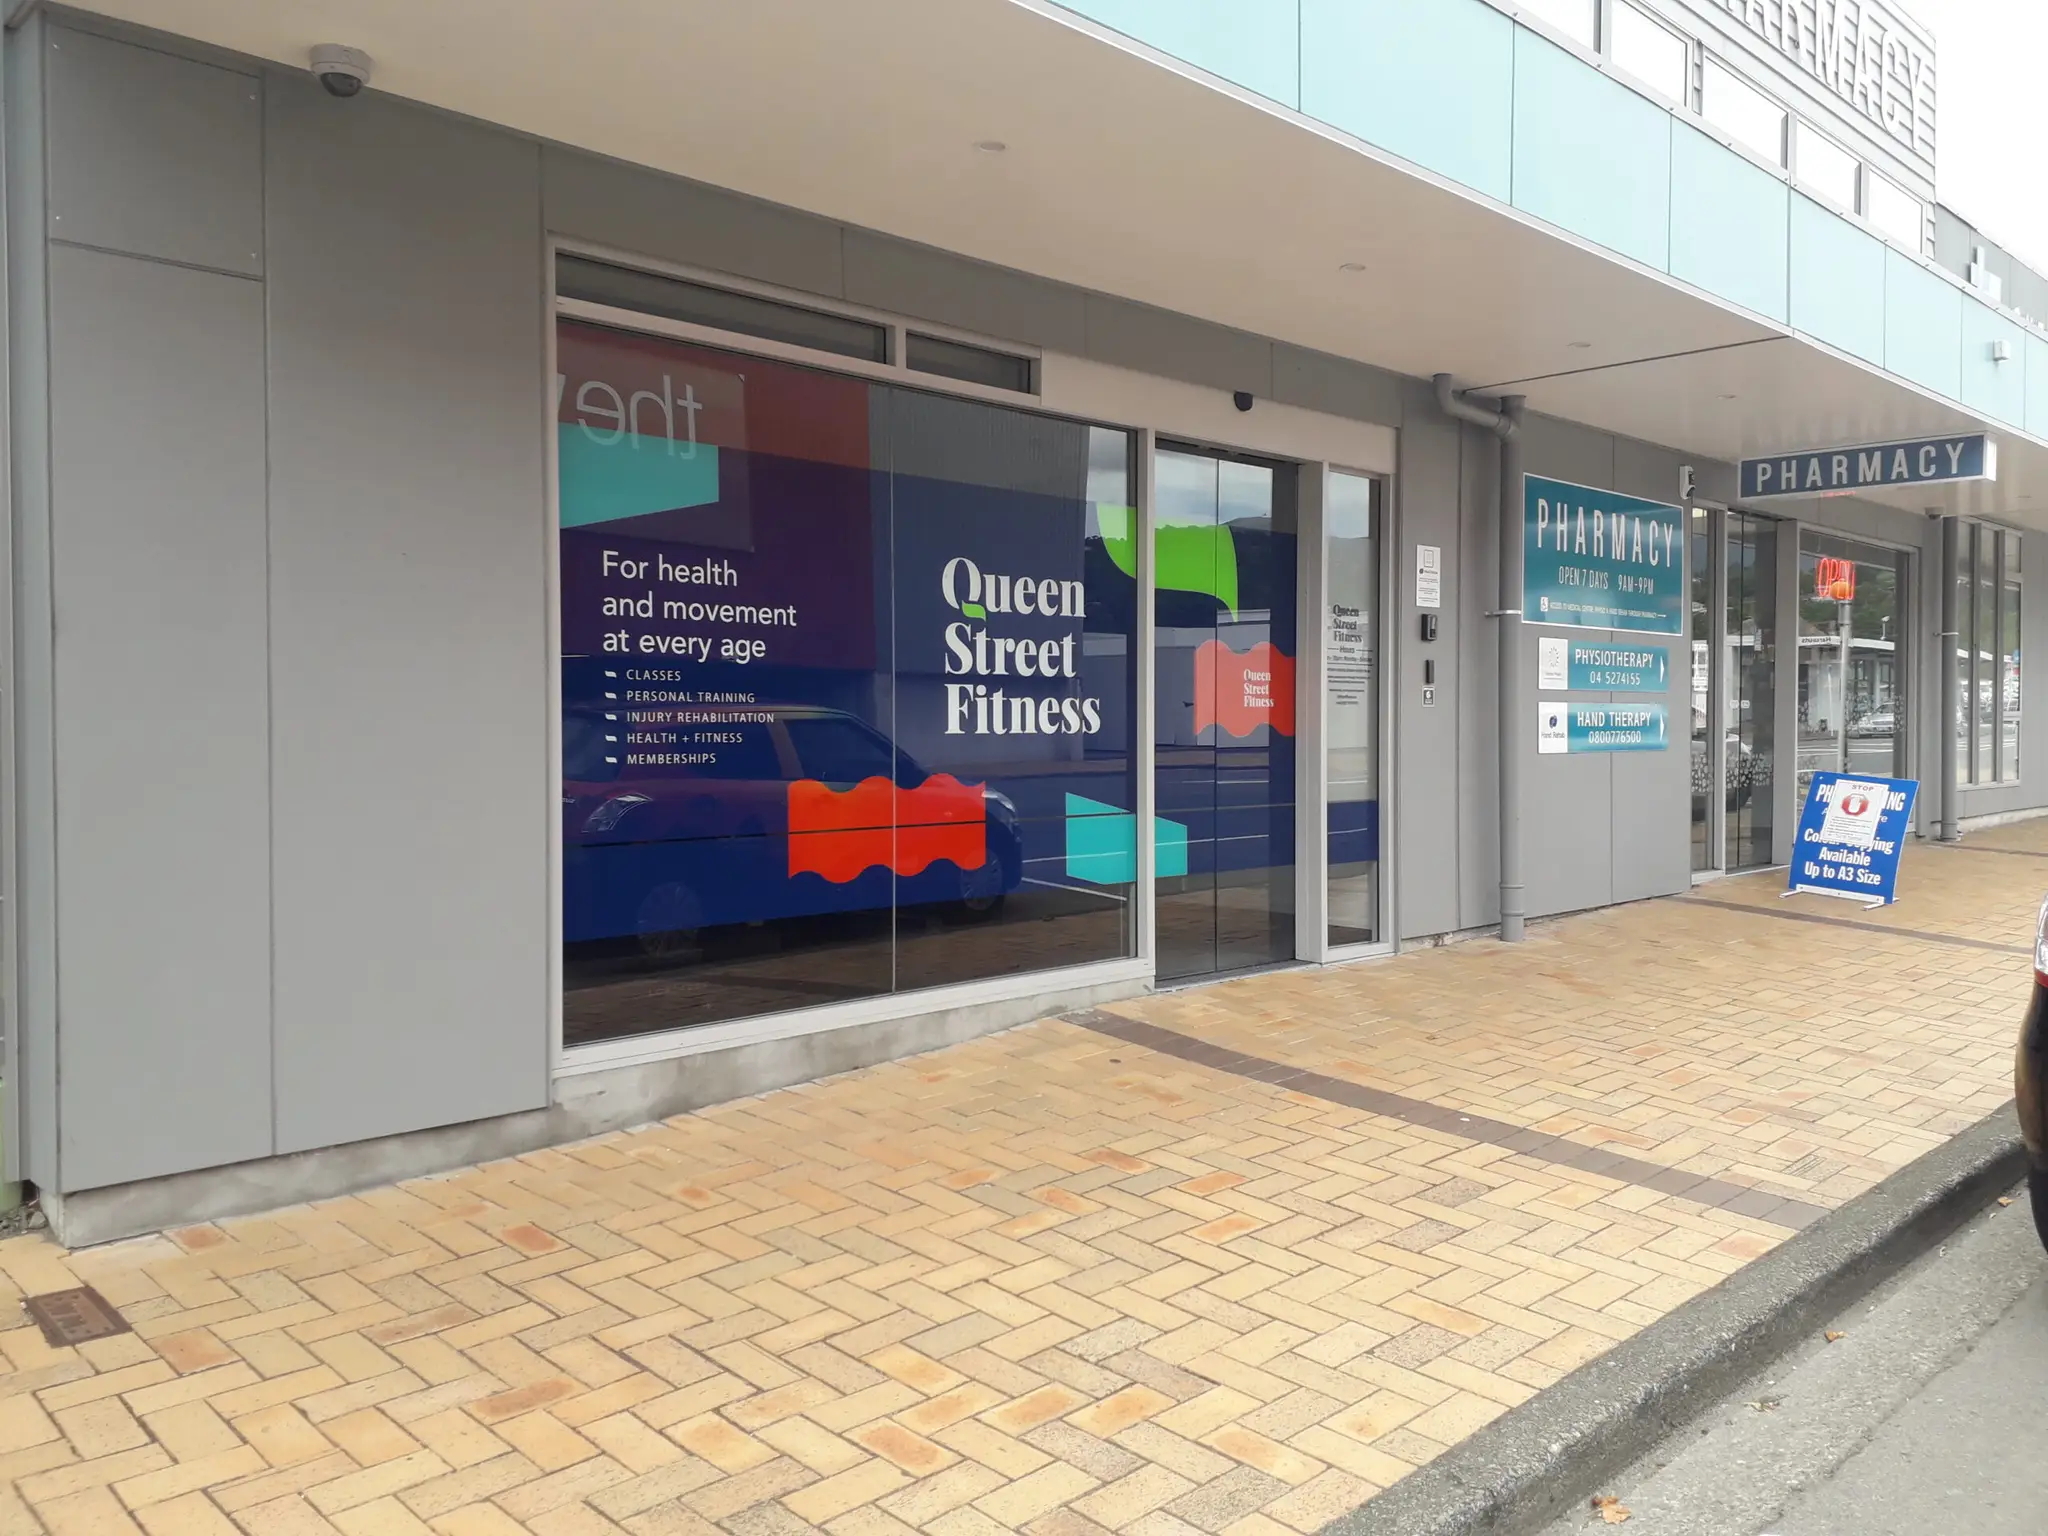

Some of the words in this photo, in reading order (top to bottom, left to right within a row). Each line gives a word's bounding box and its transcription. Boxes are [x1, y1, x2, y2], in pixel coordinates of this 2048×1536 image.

[1757, 442, 1964, 492] PHARMACY
[1537, 498, 1673, 567] PHARMACY
[603, 550, 649, 579] For
[658, 553, 738, 587] health
[1558, 566, 1579, 586] OPEN
[1582, 569, 1587, 587] 7
[1589, 570, 1609, 590] DAYS
[1617, 574, 1654, 595] 9AM-9PM
[942, 557, 1086, 621] Queen
[602, 590, 653, 618] and
[663, 600, 797, 626] movement
[1333, 604, 1359, 617] Queen
[1333, 618, 1357, 630] Street
[1334, 630, 1363, 643] Fitness
[603, 629, 629, 652] at
[639, 634, 712, 663] every
[721, 638, 766, 664] age
[945, 622, 1076, 677] Street
[1575, 648, 1653, 668] PHYSIOTHERAPY
[626, 669, 681, 681] CLASSES
[1243, 669, 1271, 681] Queen
[1590, 671, 1601, 683] 04
[1605, 671, 1640, 685] 5274155
[1243, 682, 1269, 695] Street
[627, 691, 692, 702] PERSONAL
[698, 692, 755, 703] TRAINING
[1244, 695, 1274, 707] Fitness
[944, 684, 1100, 734] Fitness
[627, 712, 672, 723] INJURY
[677, 712, 775, 723] REHABILITATION
[1577, 711, 1605, 727] HAND
[1609, 712, 1651, 727] THERAPY
[627, 733, 677, 743] HEALTH
[682, 735, 690, 743] +
[694, 732, 743, 743] FITNESS
[1588, 730, 1641, 744] 0800776500
[627, 753, 716, 764] MEMBERSHIPS
[1852, 784, 1874, 792] STOP
[1818, 847, 1871, 866] Available
[1804, 861, 1820, 879] Up
[1823, 864, 1835, 878] to
[1837, 866, 1854, 881] A3
[1856, 868, 1881, 885] Size
